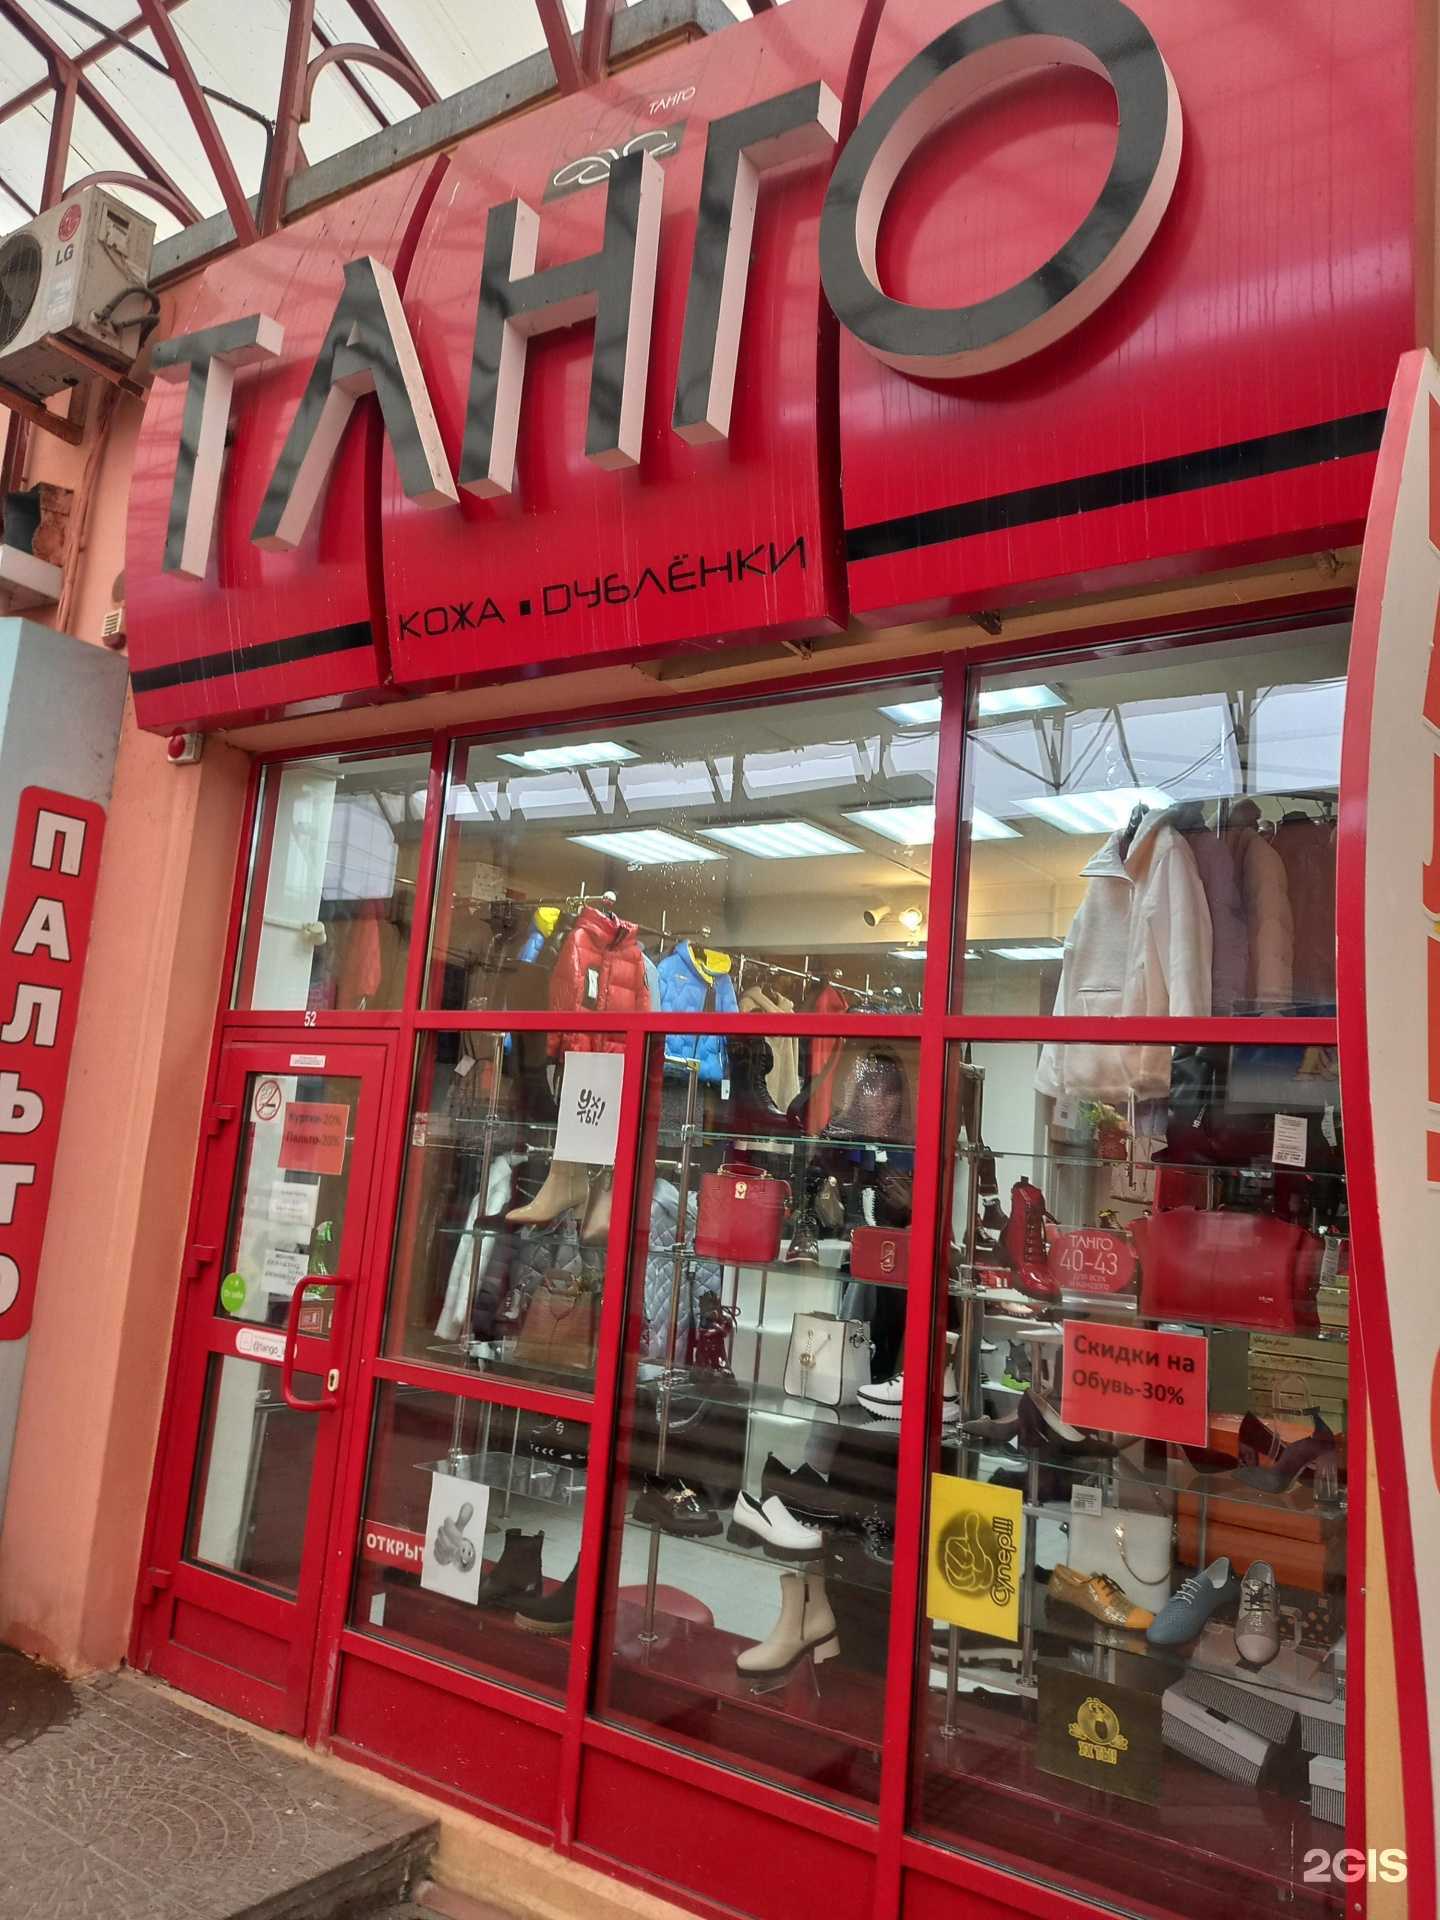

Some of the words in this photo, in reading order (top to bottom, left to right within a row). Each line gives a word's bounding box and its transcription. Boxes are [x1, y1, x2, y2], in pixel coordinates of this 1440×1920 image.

[56, 244, 74, 266] LG
[152, 0, 1184, 582] ТАНГО
[400, 597, 506, 641] КОЖА
[542, 536, 808, 617] ДУБЛЁНКИ
[304, 1011, 317, 1027] 52
[1070, 1235, 1113, 1251] ТАНГО
[1060, 1249, 1118, 1276] 40-43
[1073, 1335, 1159, 1367] Скидки
[1167, 1354, 1195, 1373] на
[1072, 1369, 1184, 1406] Обувь-30%
